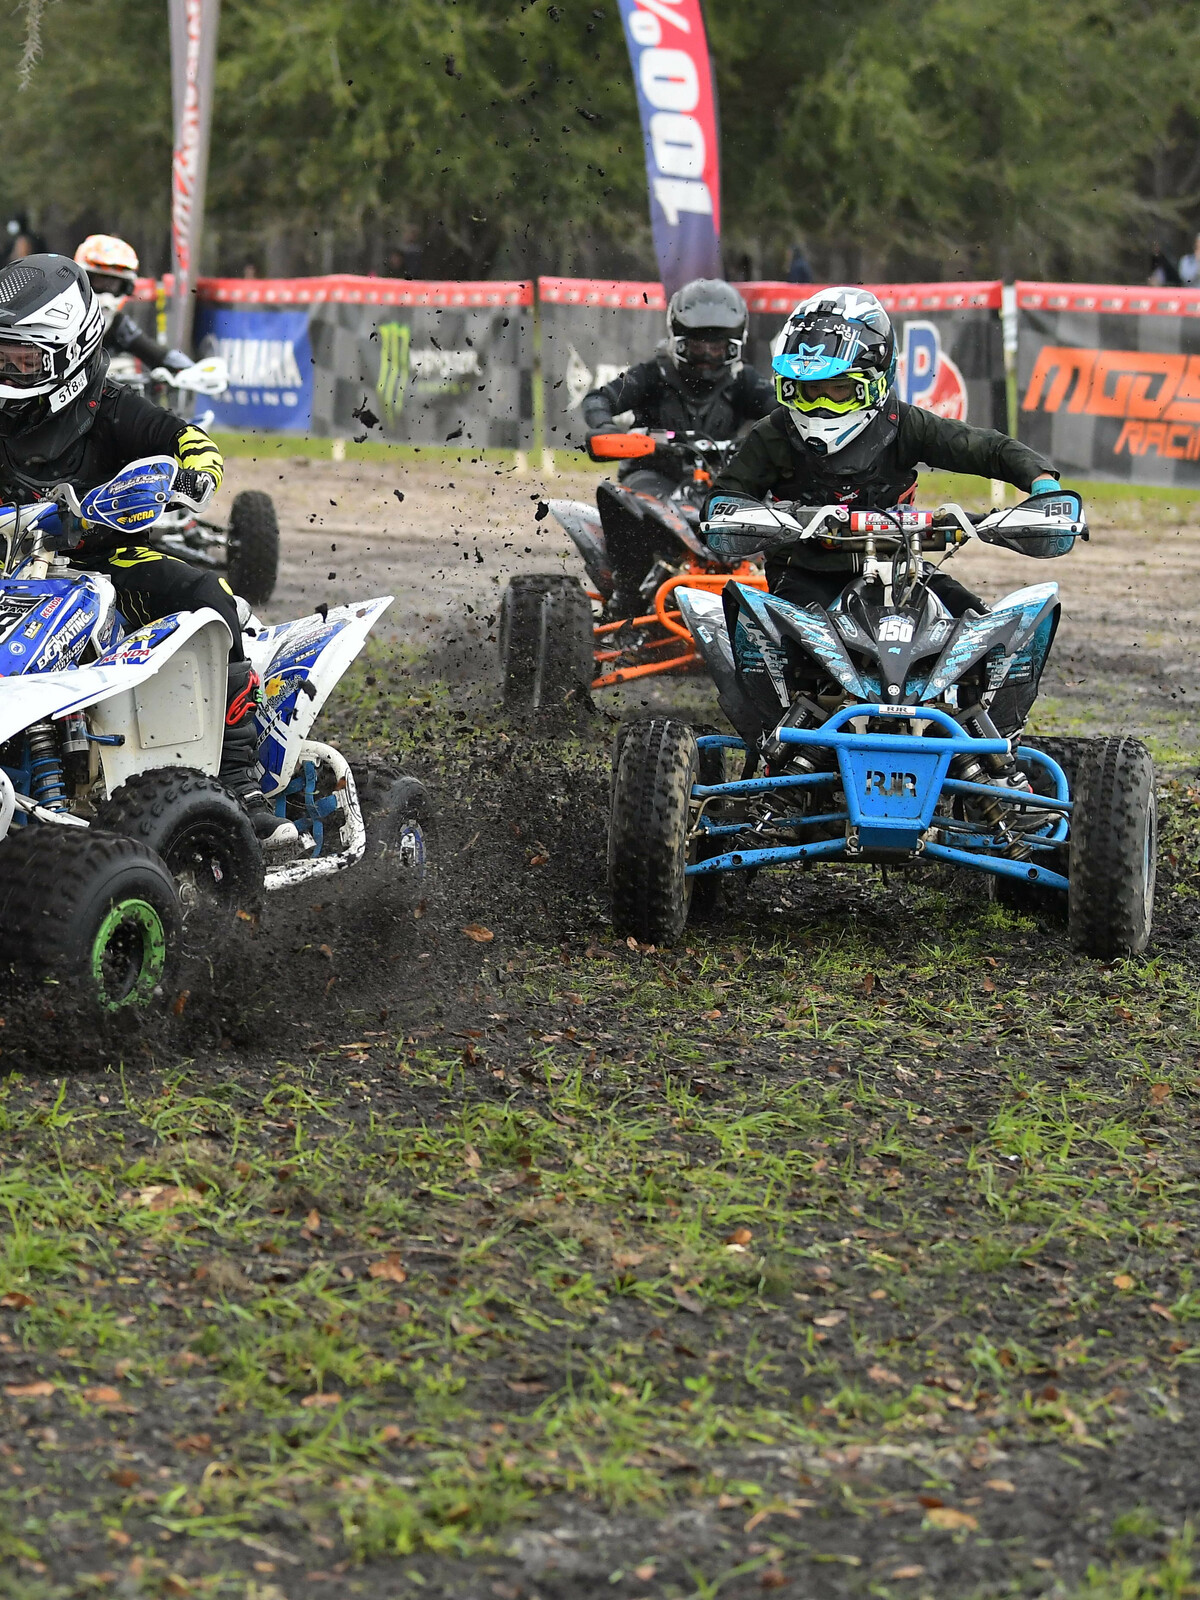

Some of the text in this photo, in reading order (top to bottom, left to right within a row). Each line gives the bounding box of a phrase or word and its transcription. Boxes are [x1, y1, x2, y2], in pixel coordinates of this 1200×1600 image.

[57, 381, 80, 404] 518
[710, 503, 738, 516] 150
[1042, 502, 1072, 517] 150
[41, 596, 63, 619] KENDA
[879, 620, 914, 642] 150
[101, 648, 150, 664] KENDA
[864, 770, 918, 797] RJR
